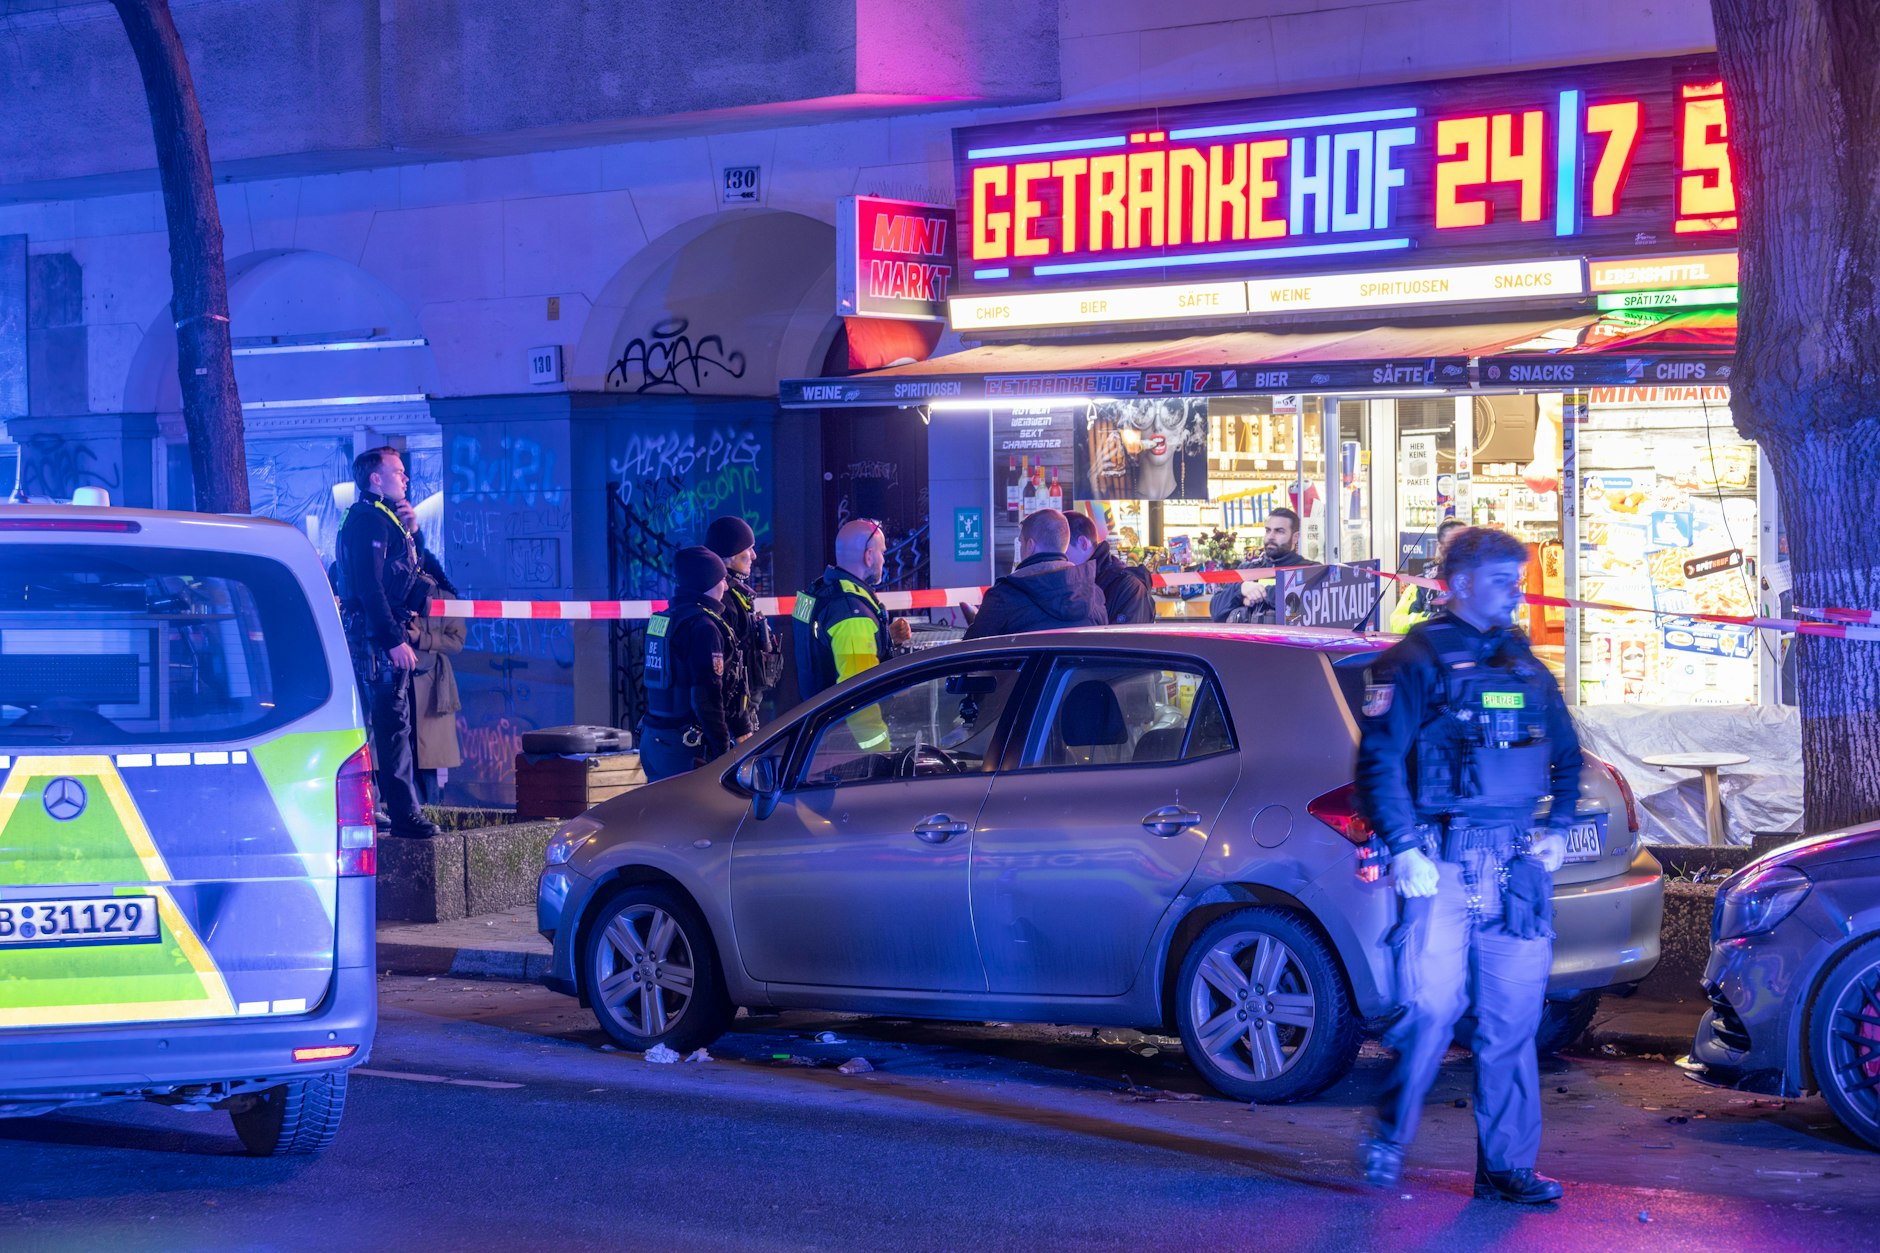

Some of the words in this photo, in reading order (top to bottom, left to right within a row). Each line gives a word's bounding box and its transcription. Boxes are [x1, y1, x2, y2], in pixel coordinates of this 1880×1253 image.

[725, 169, 756, 189] 130
[973, 132, 1416, 260] GETRÄNKEHOF
[872, 213, 948, 256] MINI
[869, 259, 952, 302] MARKT
[1595, 263, 1710, 286] LEBENSMITTEL
[1270, 287, 1311, 302] WEINE
[1360, 279, 1449, 296] SPIRITUOSEN
[1494, 273, 1553, 289] SNACKS
[976, 307, 1010, 319] CHIPS
[1080, 301, 1107, 313] BIER
[1178, 291, 1219, 307] SÄFTE
[1624, 293, 1652, 306] SPÄTI
[1654, 294, 1678, 305] 7/24
[533, 355, 552, 374] 130
[1509, 364, 1575, 382] SNACKS
[1656, 363, 1706, 380] CHIPS
[802, 385, 842, 400] WEINE
[894, 381, 961, 398] SPIRITUOSEN
[985, 374, 1140, 396] GETRÄNKEHOF
[1255, 371, 1289, 388] BIER
[1373, 364, 1423, 384] SÄFTE
[1019, 428, 1044, 438] SEKT
[1002, 438, 1062, 450] CHAMPAGNER
[1408, 450, 1427, 459] KEINE
[1409, 442, 1425, 451] HIER
[1406, 478, 1430, 487] PAKETE
[1302, 581, 1375, 627] SPÄTKAUF
[39, 903, 143, 935] 31129
